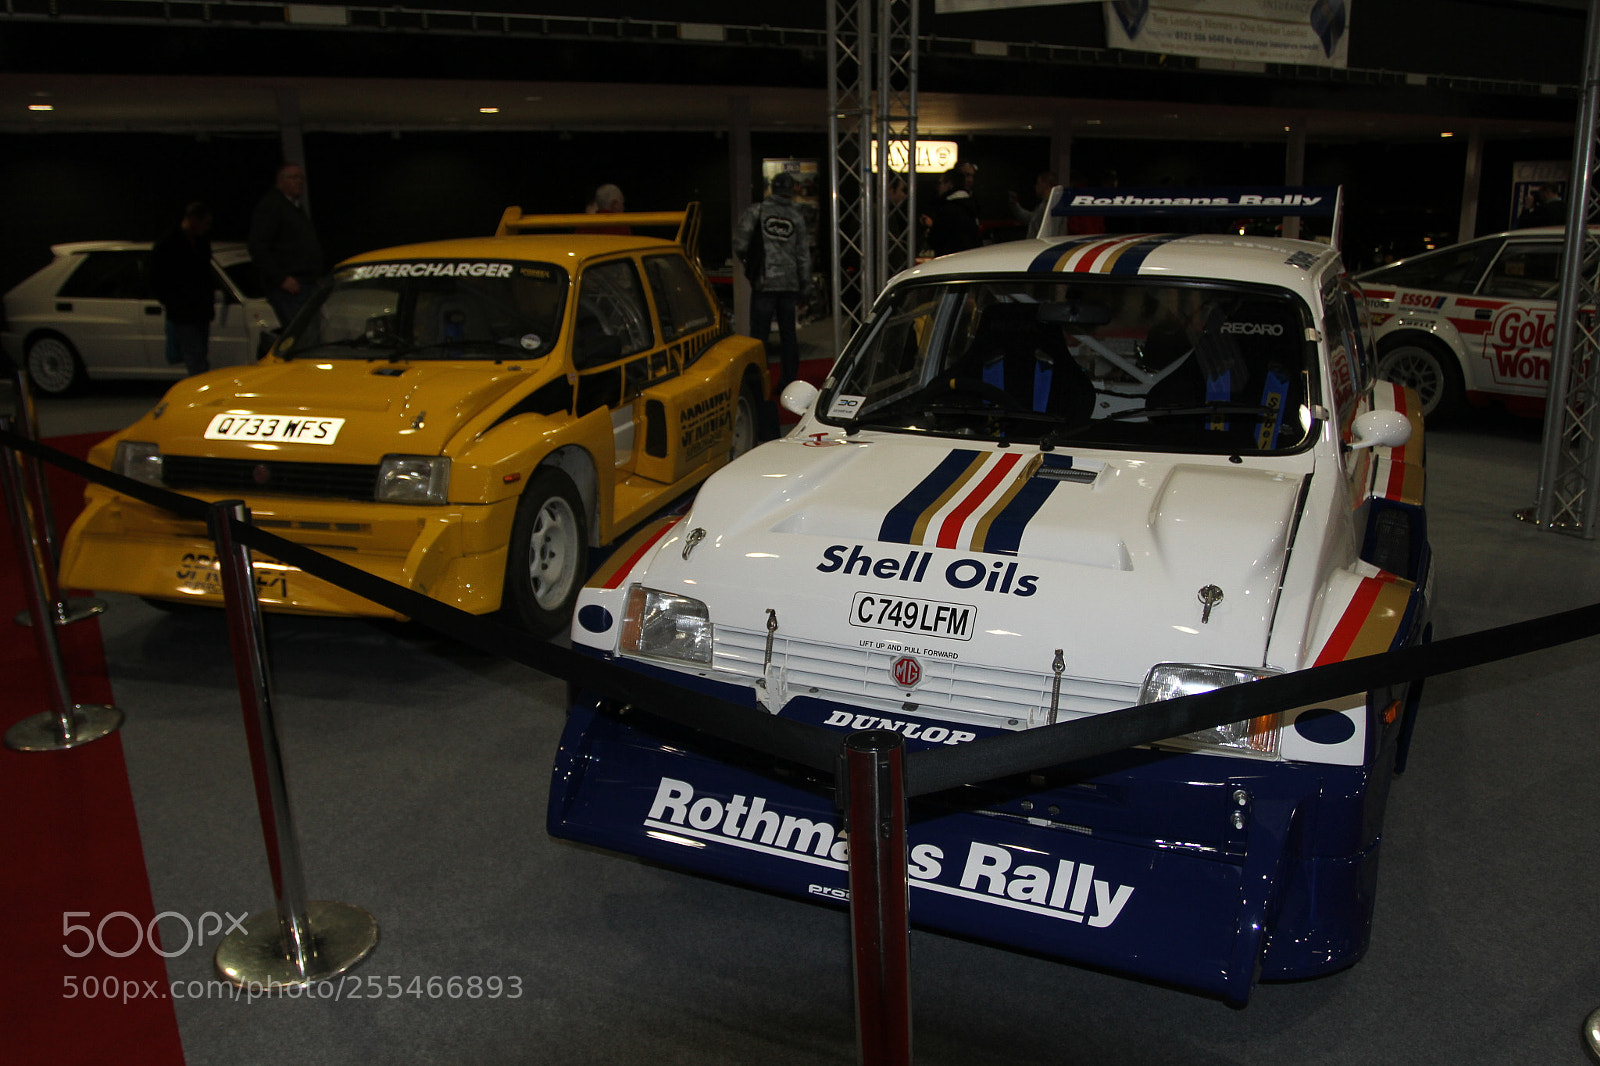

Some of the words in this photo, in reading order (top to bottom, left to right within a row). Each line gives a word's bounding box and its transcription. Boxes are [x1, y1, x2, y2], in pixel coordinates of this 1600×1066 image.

[1071, 195, 1229, 207] Rothmans
[1238, 194, 1323, 207] Rally
[353, 263, 514, 280] SUPERCHARGER
[1401, 293, 1432, 308] ESSO
[1220, 322, 1284, 336] RECARO
[218, 417, 280, 437] Q733
[283, 419, 332, 439] WFS
[816, 545, 934, 583] Shell
[945, 558, 1040, 597] Oils
[859, 640, 873, 649] LIFT
[875, 642, 886, 650] UP
[887, 644, 902, 652] AND
[904, 646, 922, 655] PULL
[923, 648, 959, 660] FORWARD
[894, 659, 921, 686] MG
[823, 710, 977, 746] DUNLOP
[645, 777, 945, 880] Rothmas
[959, 841, 1135, 928] Rally
